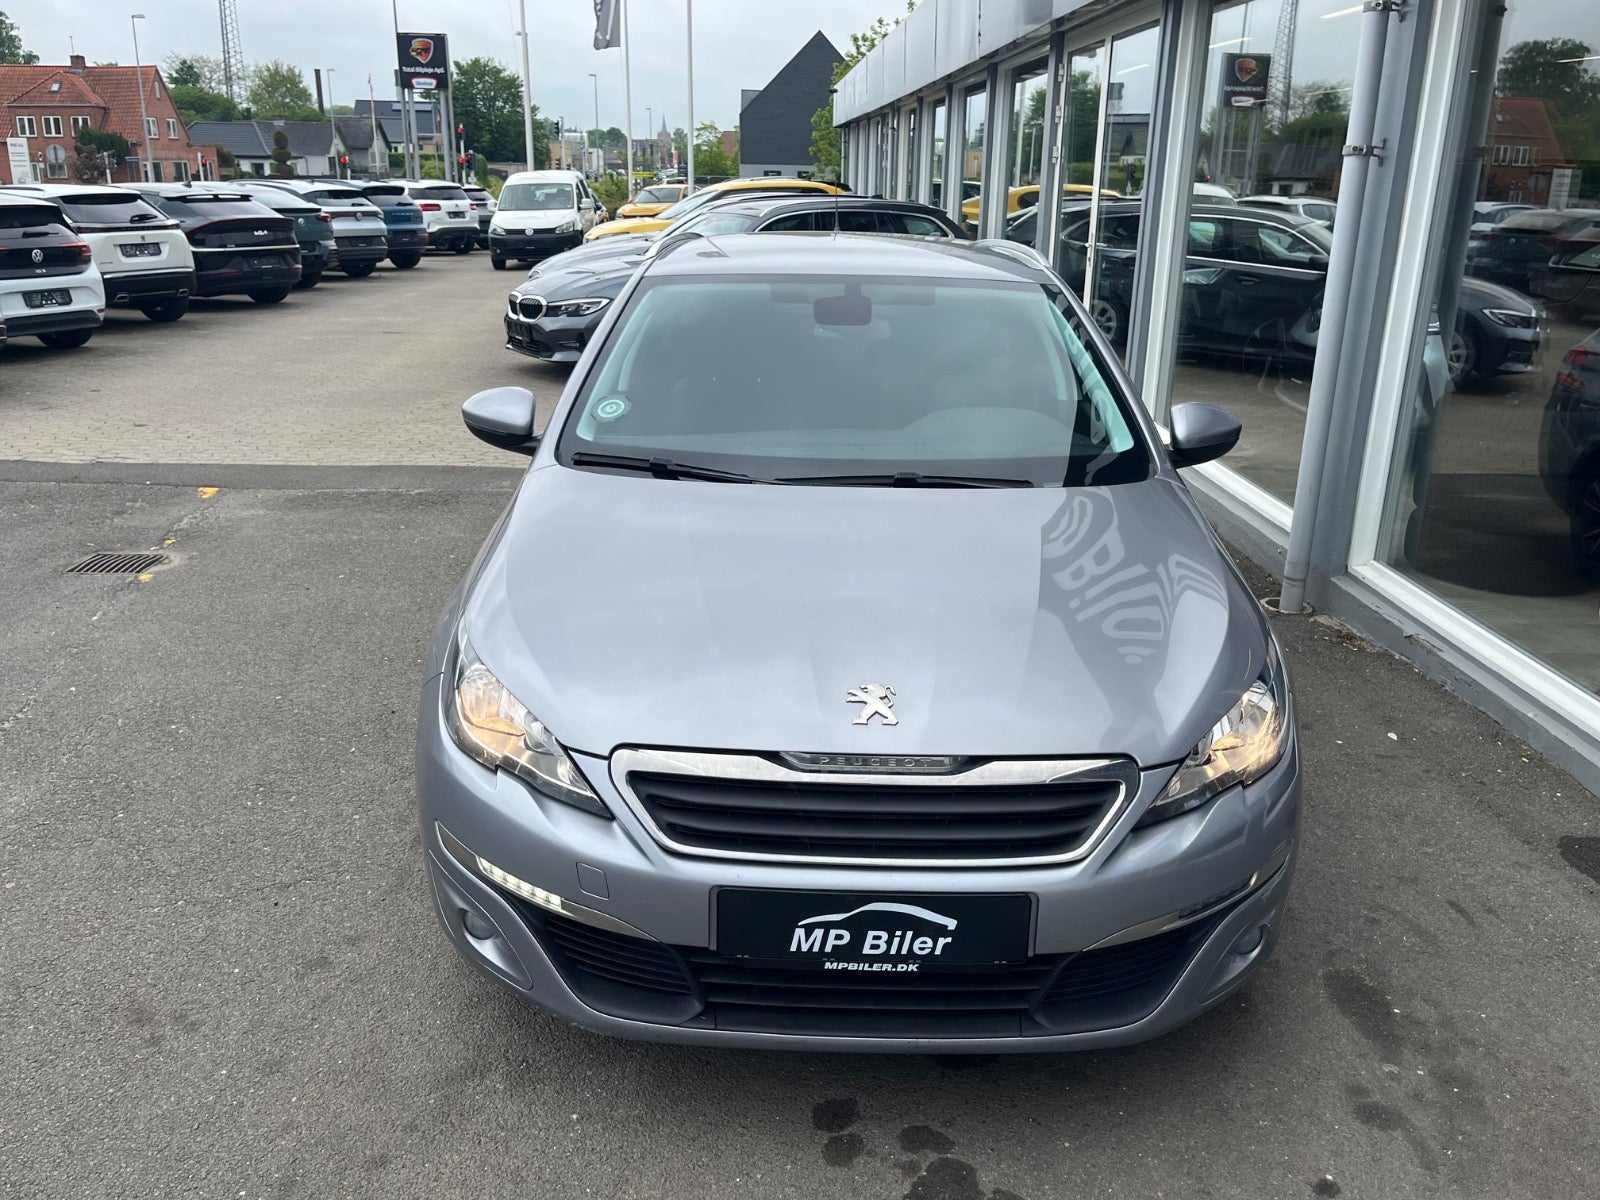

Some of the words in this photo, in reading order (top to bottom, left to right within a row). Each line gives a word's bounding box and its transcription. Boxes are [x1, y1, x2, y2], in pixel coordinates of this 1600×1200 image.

[818, 755, 932, 768] PEUGEOT
[789, 927, 851, 953] MP
[862, 930, 953, 955] Biler
[824, 960, 920, 972] MPBILER.DK
